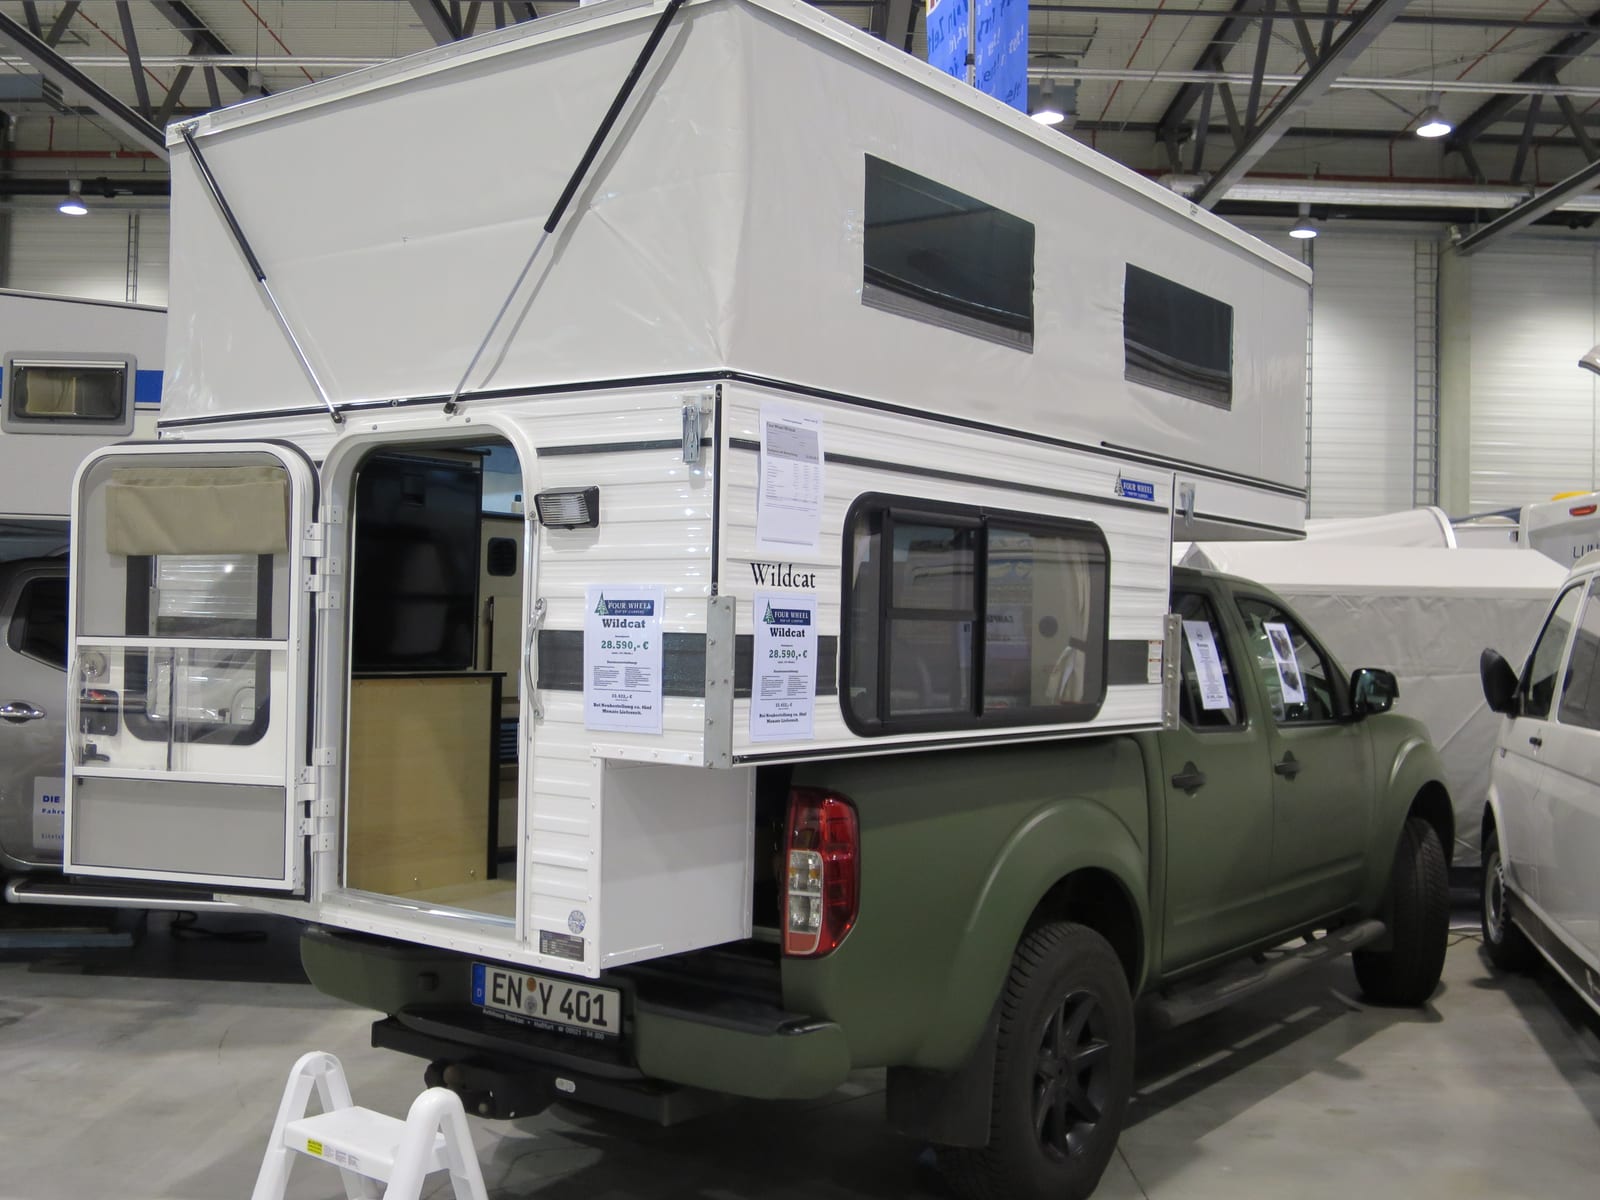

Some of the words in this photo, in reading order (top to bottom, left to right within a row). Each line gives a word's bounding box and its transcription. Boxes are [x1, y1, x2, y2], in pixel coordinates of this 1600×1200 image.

[750, 562, 816, 588] Wildcat
[608, 600, 626, 609] FOUR
[774, 610, 789, 618] FOUR
[790, 611, 809, 619] WHEEL
[602, 618, 646, 629] Wildcat
[769, 627, 806, 638] Wildcat
[601, 640, 641, 651] 28.590,-
[42, 795, 60, 803] DIE
[492, 972, 522, 1008] EN
[539, 982, 553, 1015] Y
[559, 988, 607, 1027] 401
